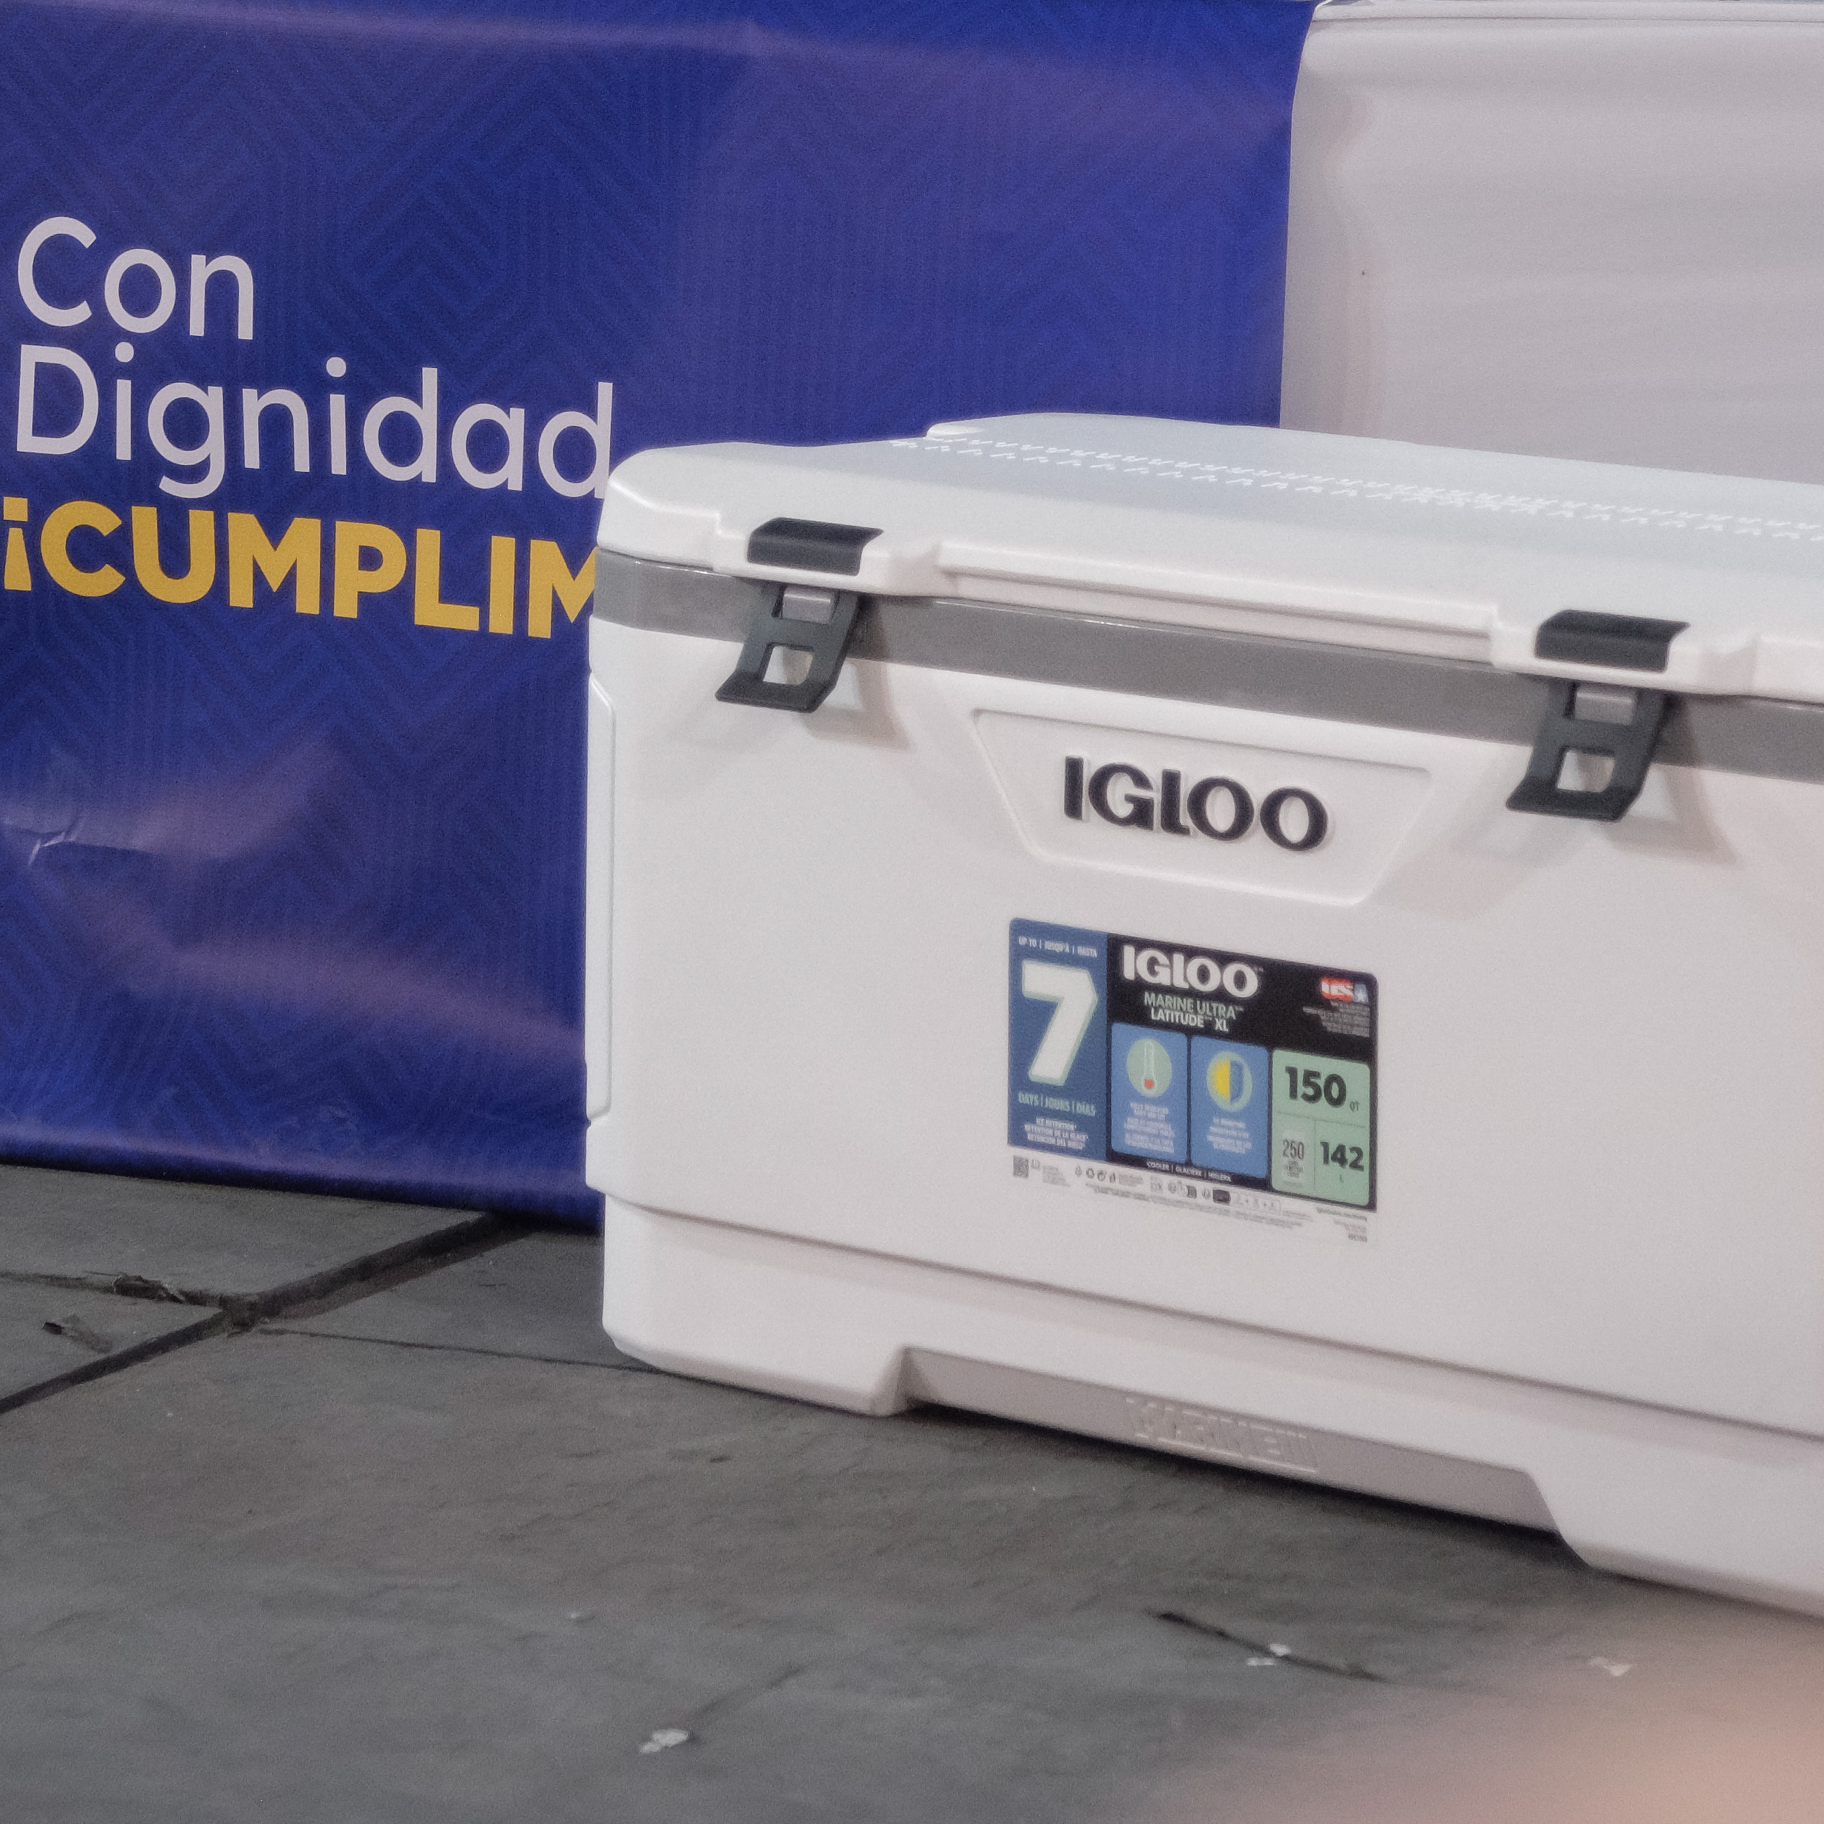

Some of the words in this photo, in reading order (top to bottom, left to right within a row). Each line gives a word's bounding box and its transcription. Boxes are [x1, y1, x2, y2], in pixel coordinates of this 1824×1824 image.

[17, 216, 254, 340] Con
[16, 341, 613, 499] Dignidad
[1064, 755, 1329, 853] IGLOO
[1123, 945, 1259, 997] IGLOO
[1021, 959, 1097, 1086] 7
[1144, 992, 1194, 1012] MARINE
[1197, 1000, 1236, 1019] ULTRA
[1151, 1008, 1205, 1027] LATITUDE
[1215, 1018, 1229, 1032] XL
[1018, 1091, 1039, 1106] DAYS
[1045, 1096, 1070, 1112] JOURS
[1285, 1066, 1346, 1108] 150
[1283, 1139, 1304, 1160] 250
[1320, 1141, 1364, 1172] 142
